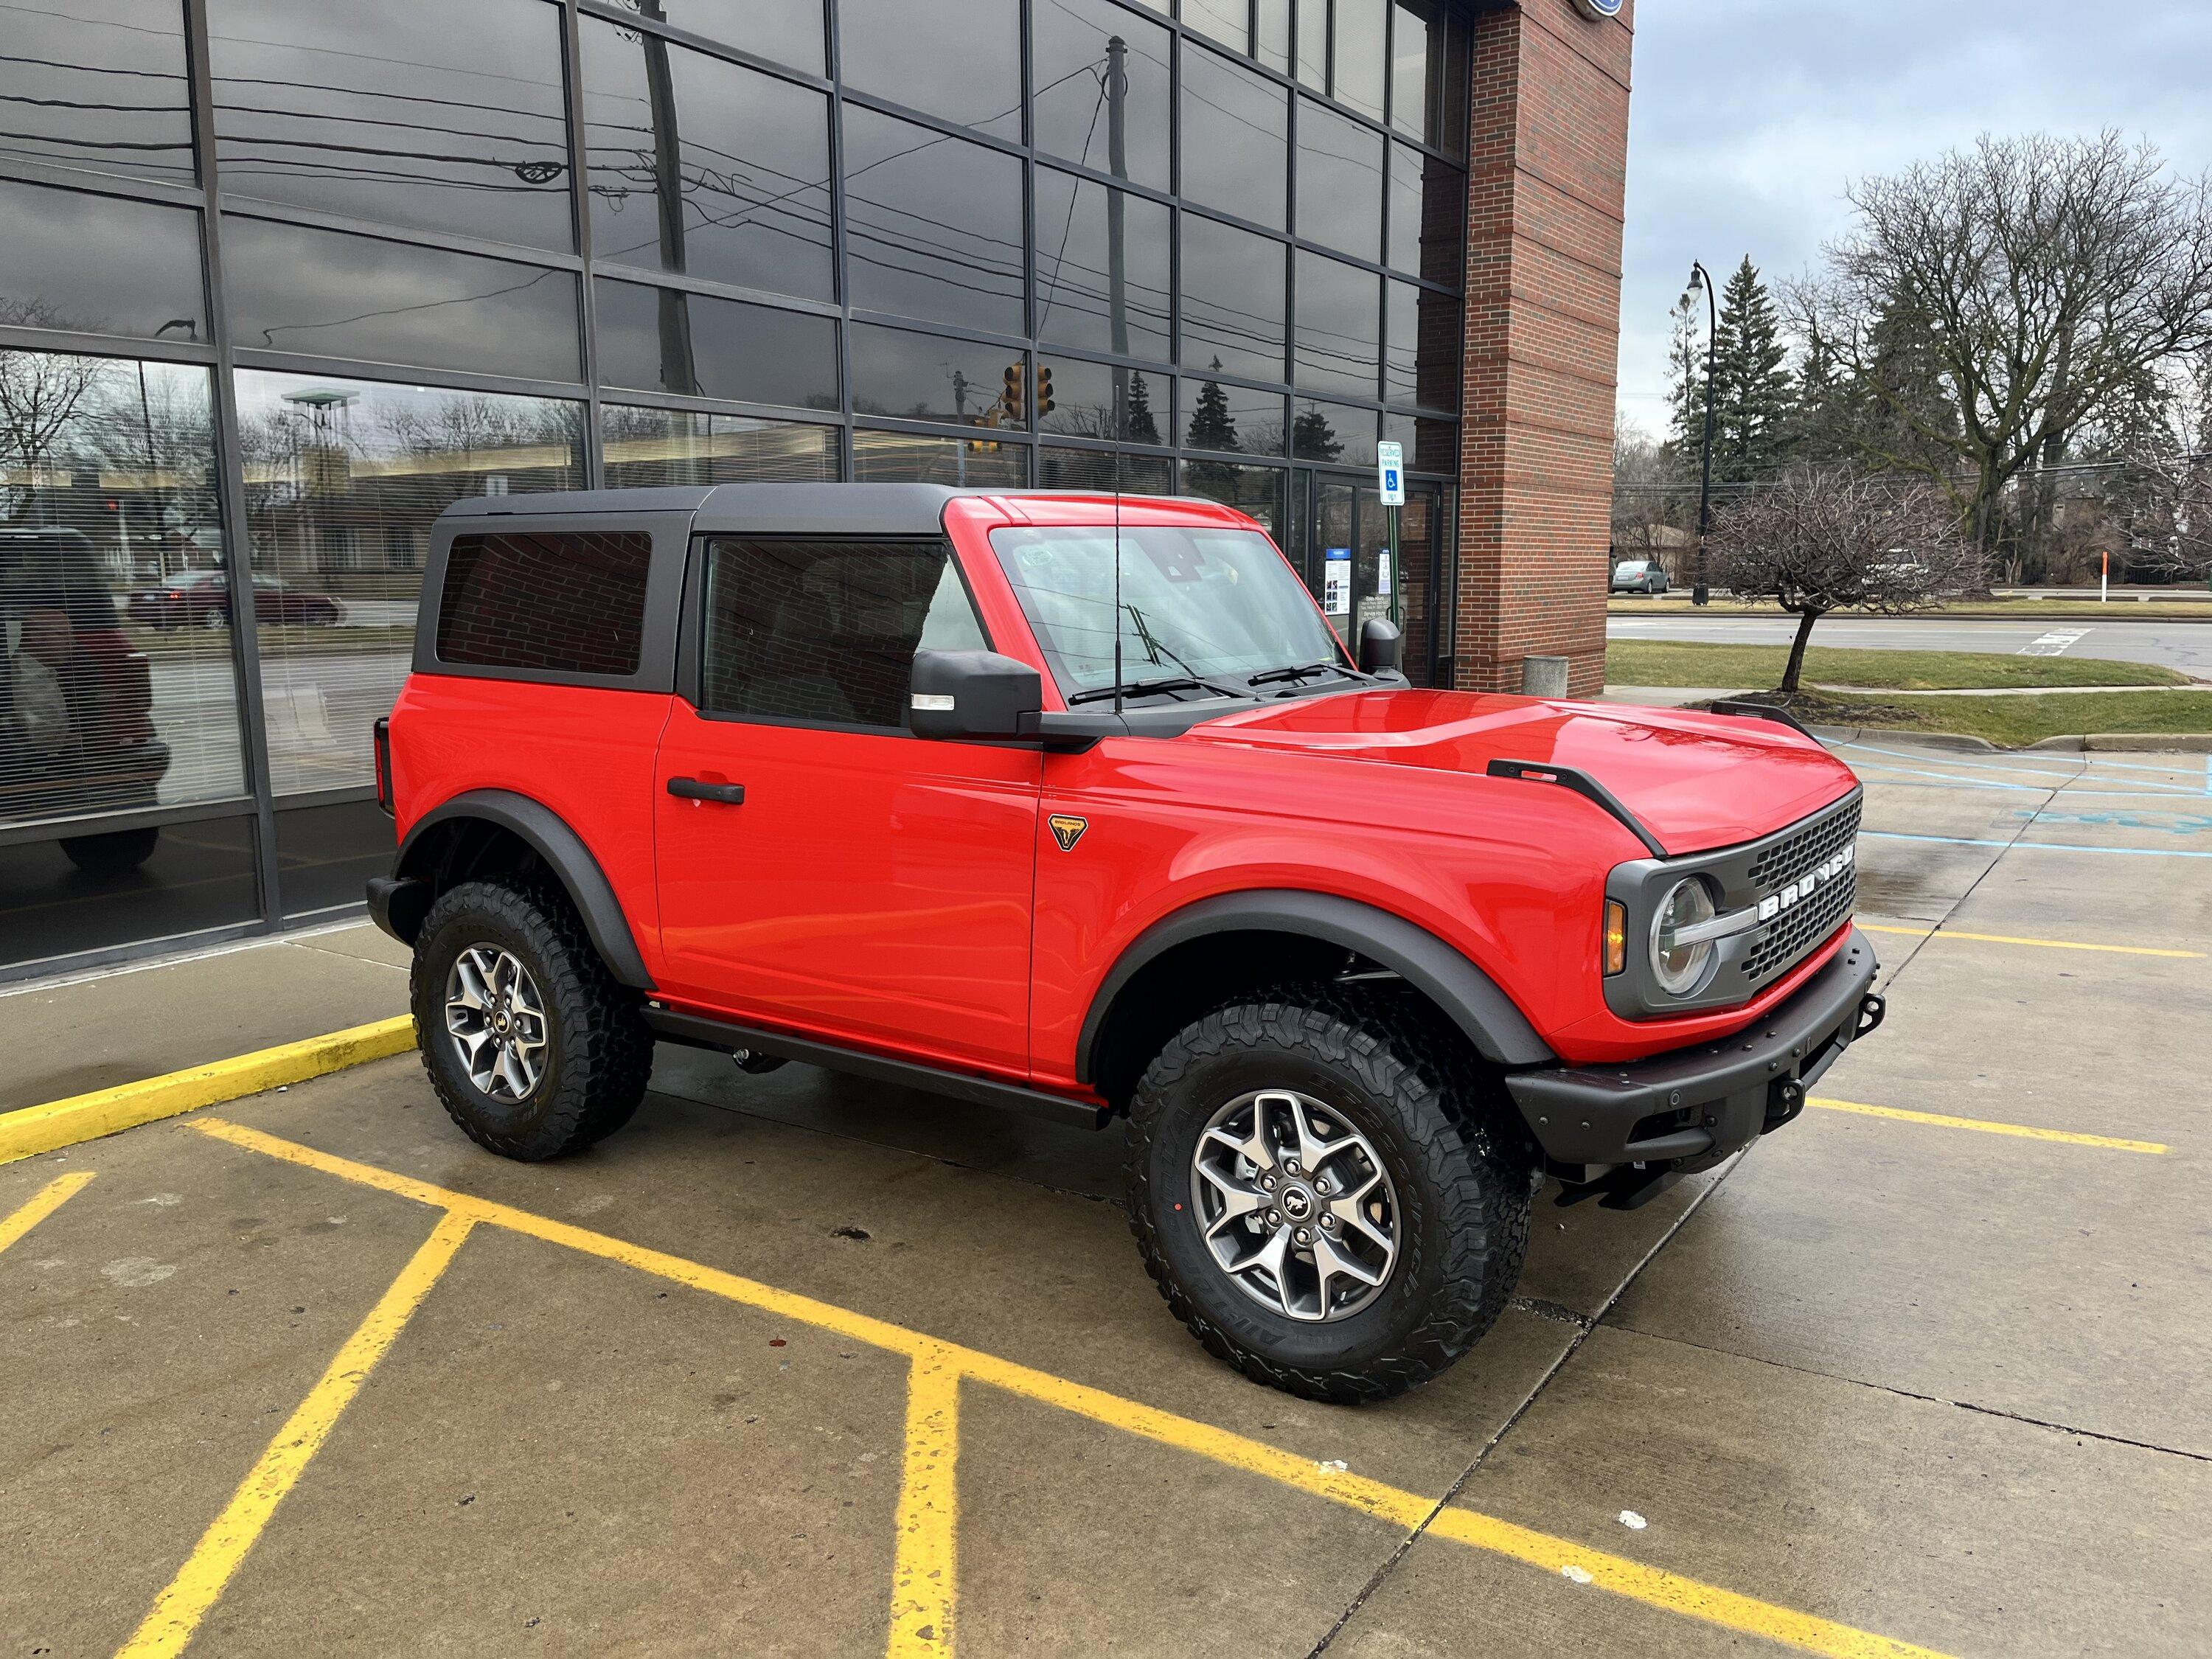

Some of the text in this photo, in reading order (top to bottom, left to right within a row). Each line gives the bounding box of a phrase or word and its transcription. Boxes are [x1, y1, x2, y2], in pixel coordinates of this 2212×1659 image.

[1380, 448, 1400, 457] RESERVED
[1381, 459, 1399, 467] PARKING
[1759, 844, 1854, 921] BRONCO
